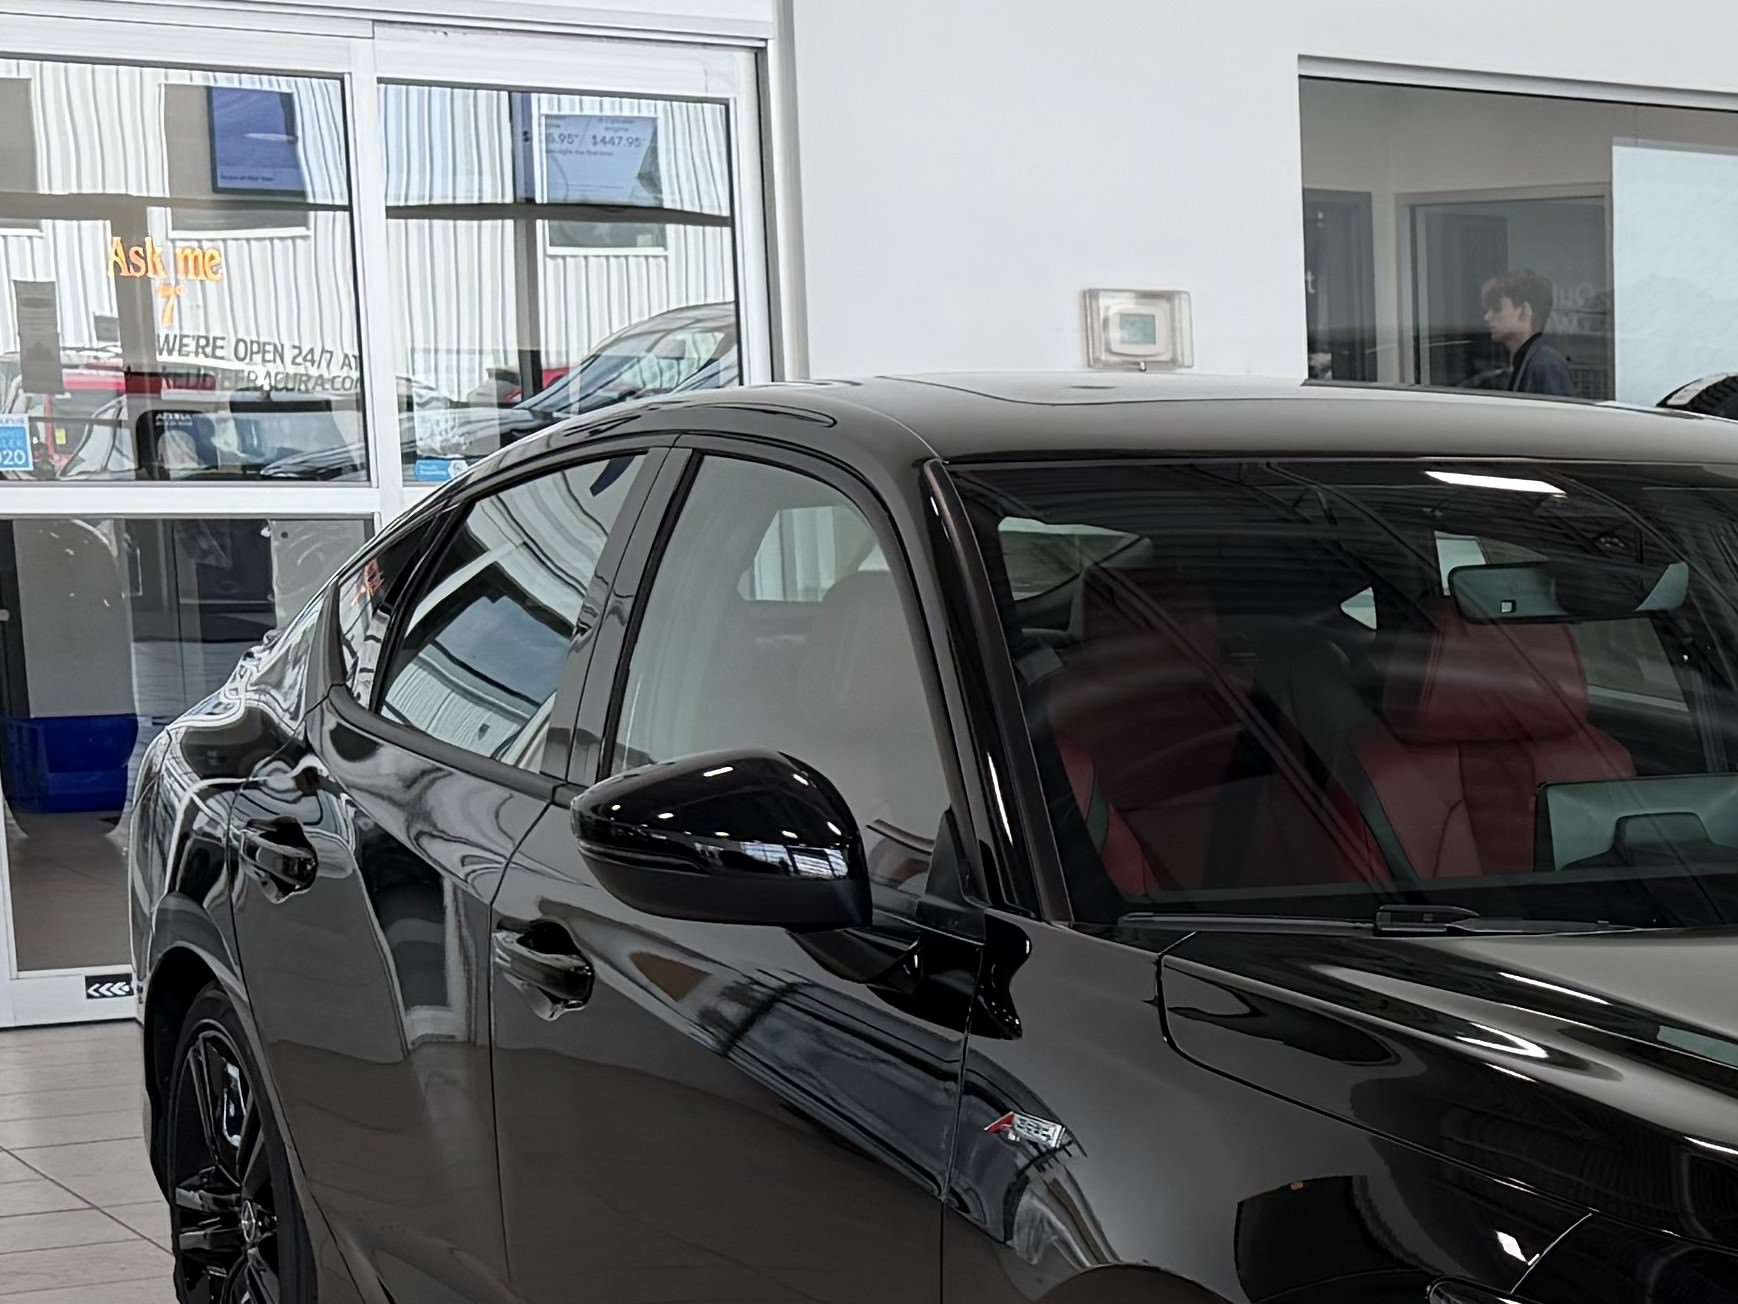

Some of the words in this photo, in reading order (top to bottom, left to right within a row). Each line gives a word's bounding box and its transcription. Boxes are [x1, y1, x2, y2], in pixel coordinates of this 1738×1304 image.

[107, 236, 168, 279] Ask
[175, 245, 224, 282] me
[233, 338, 285, 366] OPEN
[290, 344, 334, 370] 24/7
